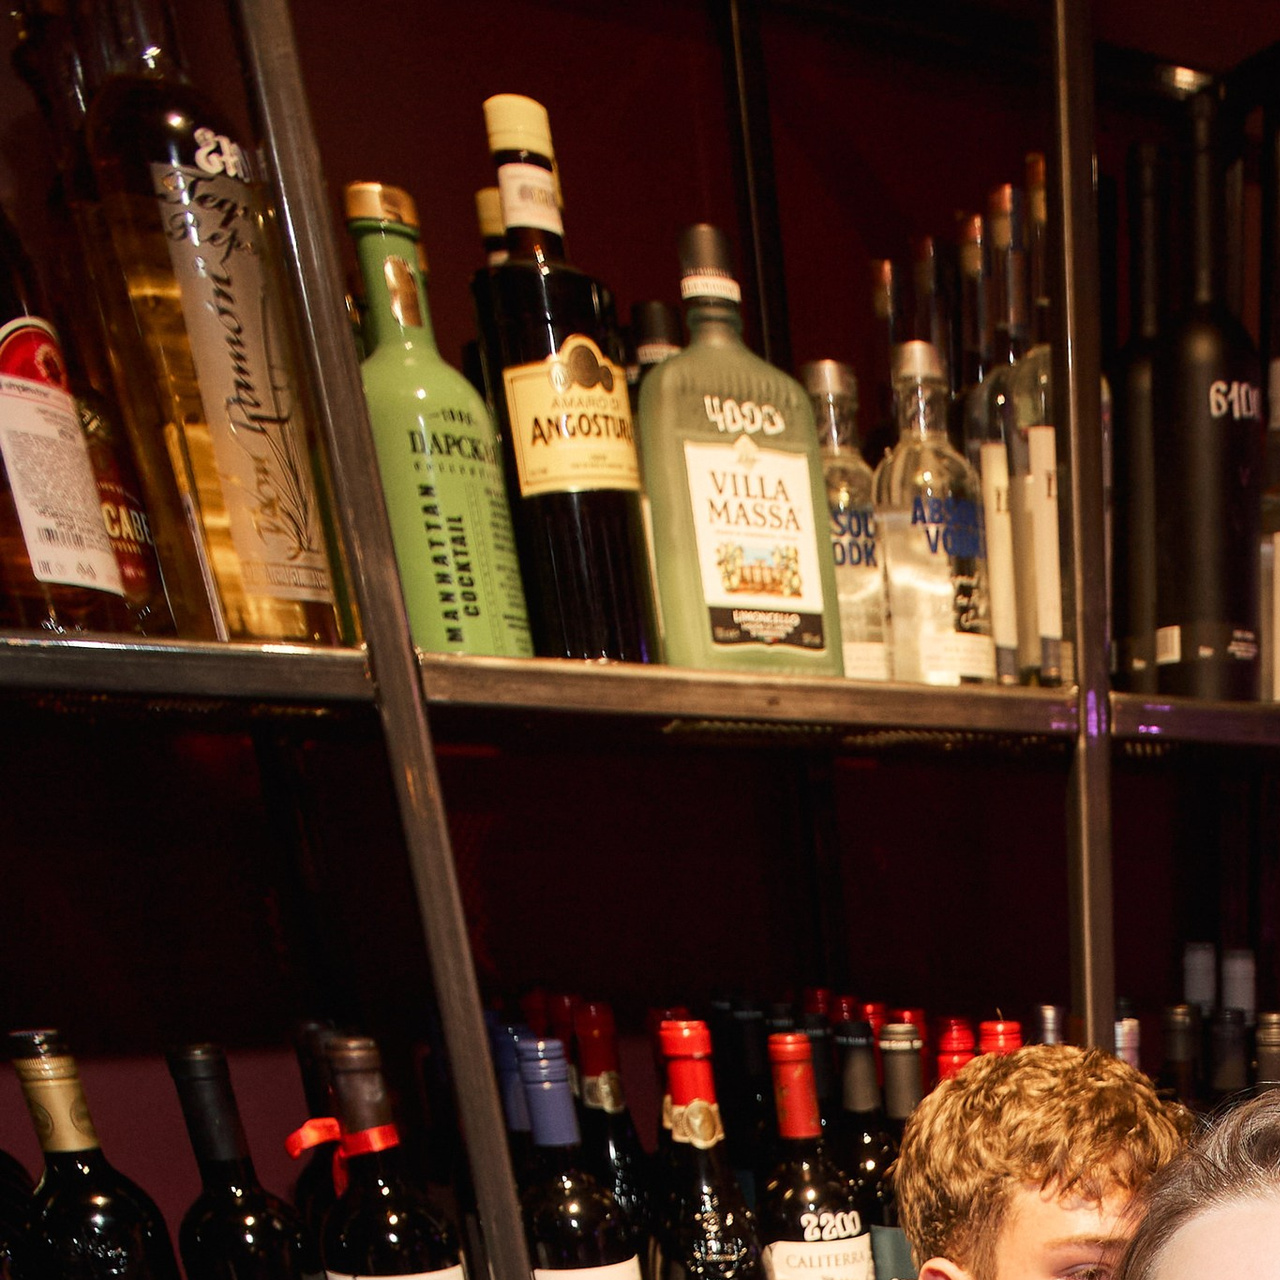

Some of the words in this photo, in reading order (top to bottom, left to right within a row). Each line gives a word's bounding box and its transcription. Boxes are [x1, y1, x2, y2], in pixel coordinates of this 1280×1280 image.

[703, 394, 786, 436] 4000
[709, 470, 790, 502] VILLA
[708, 498, 802, 532] MASSA
[417, 483, 464, 643] MANHATTAN
[446, 515, 480, 618] COCKTAIL
[800, 1210, 862, 1242] 2200
